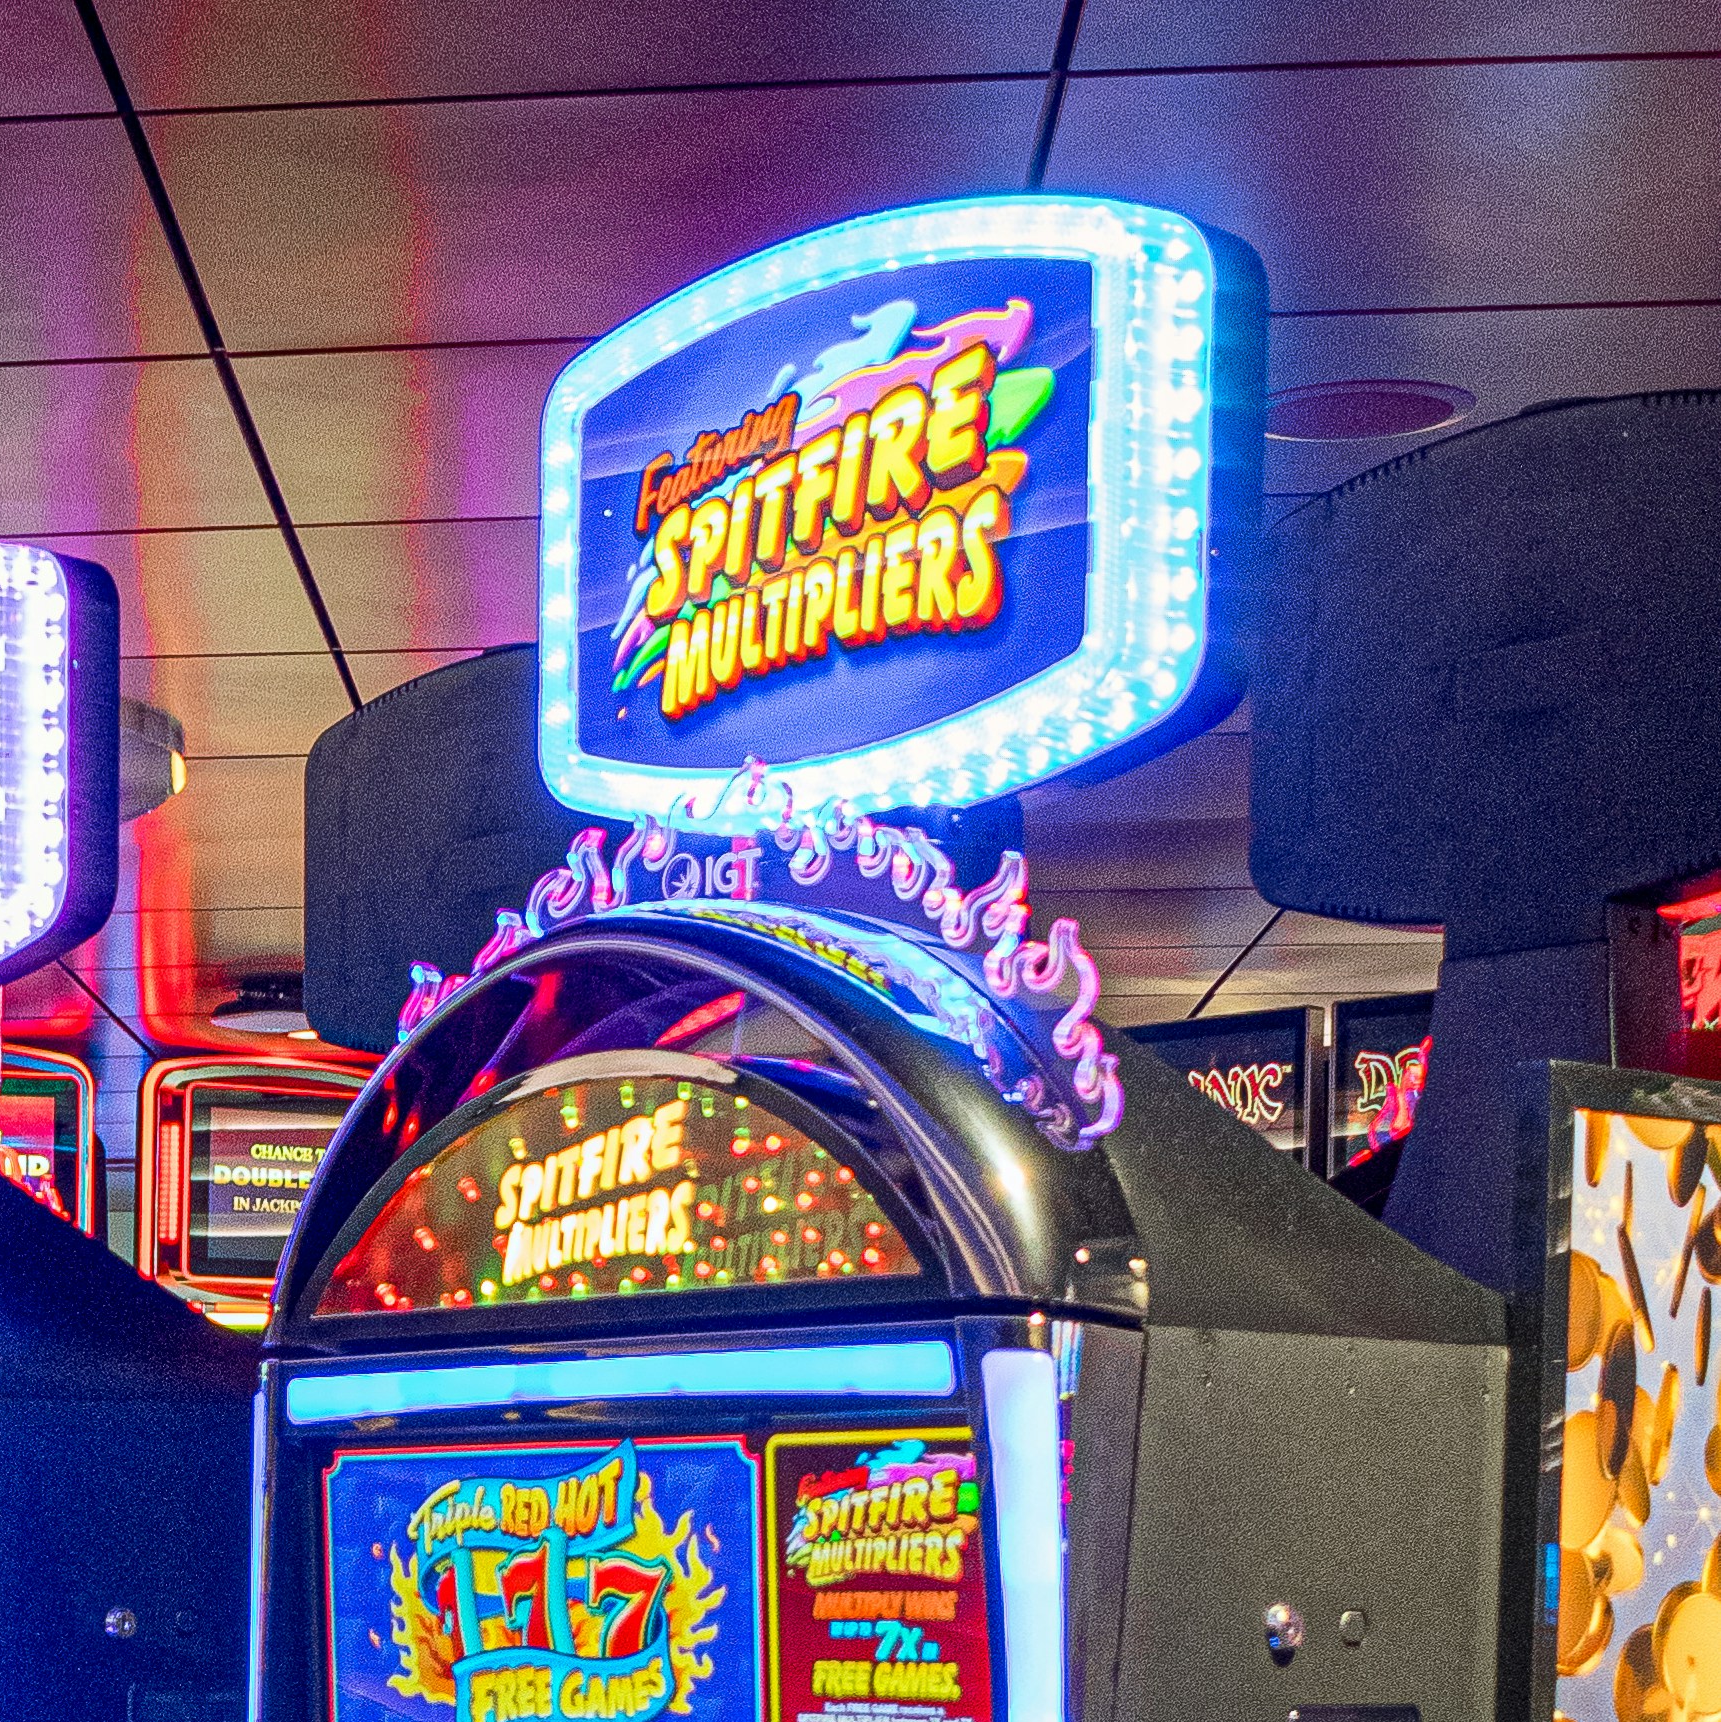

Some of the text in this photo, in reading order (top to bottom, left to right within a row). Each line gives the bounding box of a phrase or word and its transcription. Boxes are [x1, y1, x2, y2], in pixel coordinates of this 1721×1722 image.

[634, 392, 802, 535] Featuring
[644, 341, 997, 619] SPITFIRE
[661, 482, 1012, 720] MULTIPLIERS
[706, 848, 762, 896] IGT
[213, 1165, 312, 1190] DOUBLE
[251, 1144, 313, 1163] CHANCE
[496, 1100, 687, 1227] SPITFIRE
[233, 1197, 250, 1211] IN
[503, 1181, 696, 1287] MULTIPLIERS
[408, 1458, 623, 1554] Triple RED HOT
[802, 1469, 959, 1540] SPITFIRE
[806, 1529, 968, 1587] MULTIPLIERS
[587, 1550, 673, 1660] 7
[558, 1658, 666, 1721] GAMES
[812, 1660, 872, 1698] FREE
